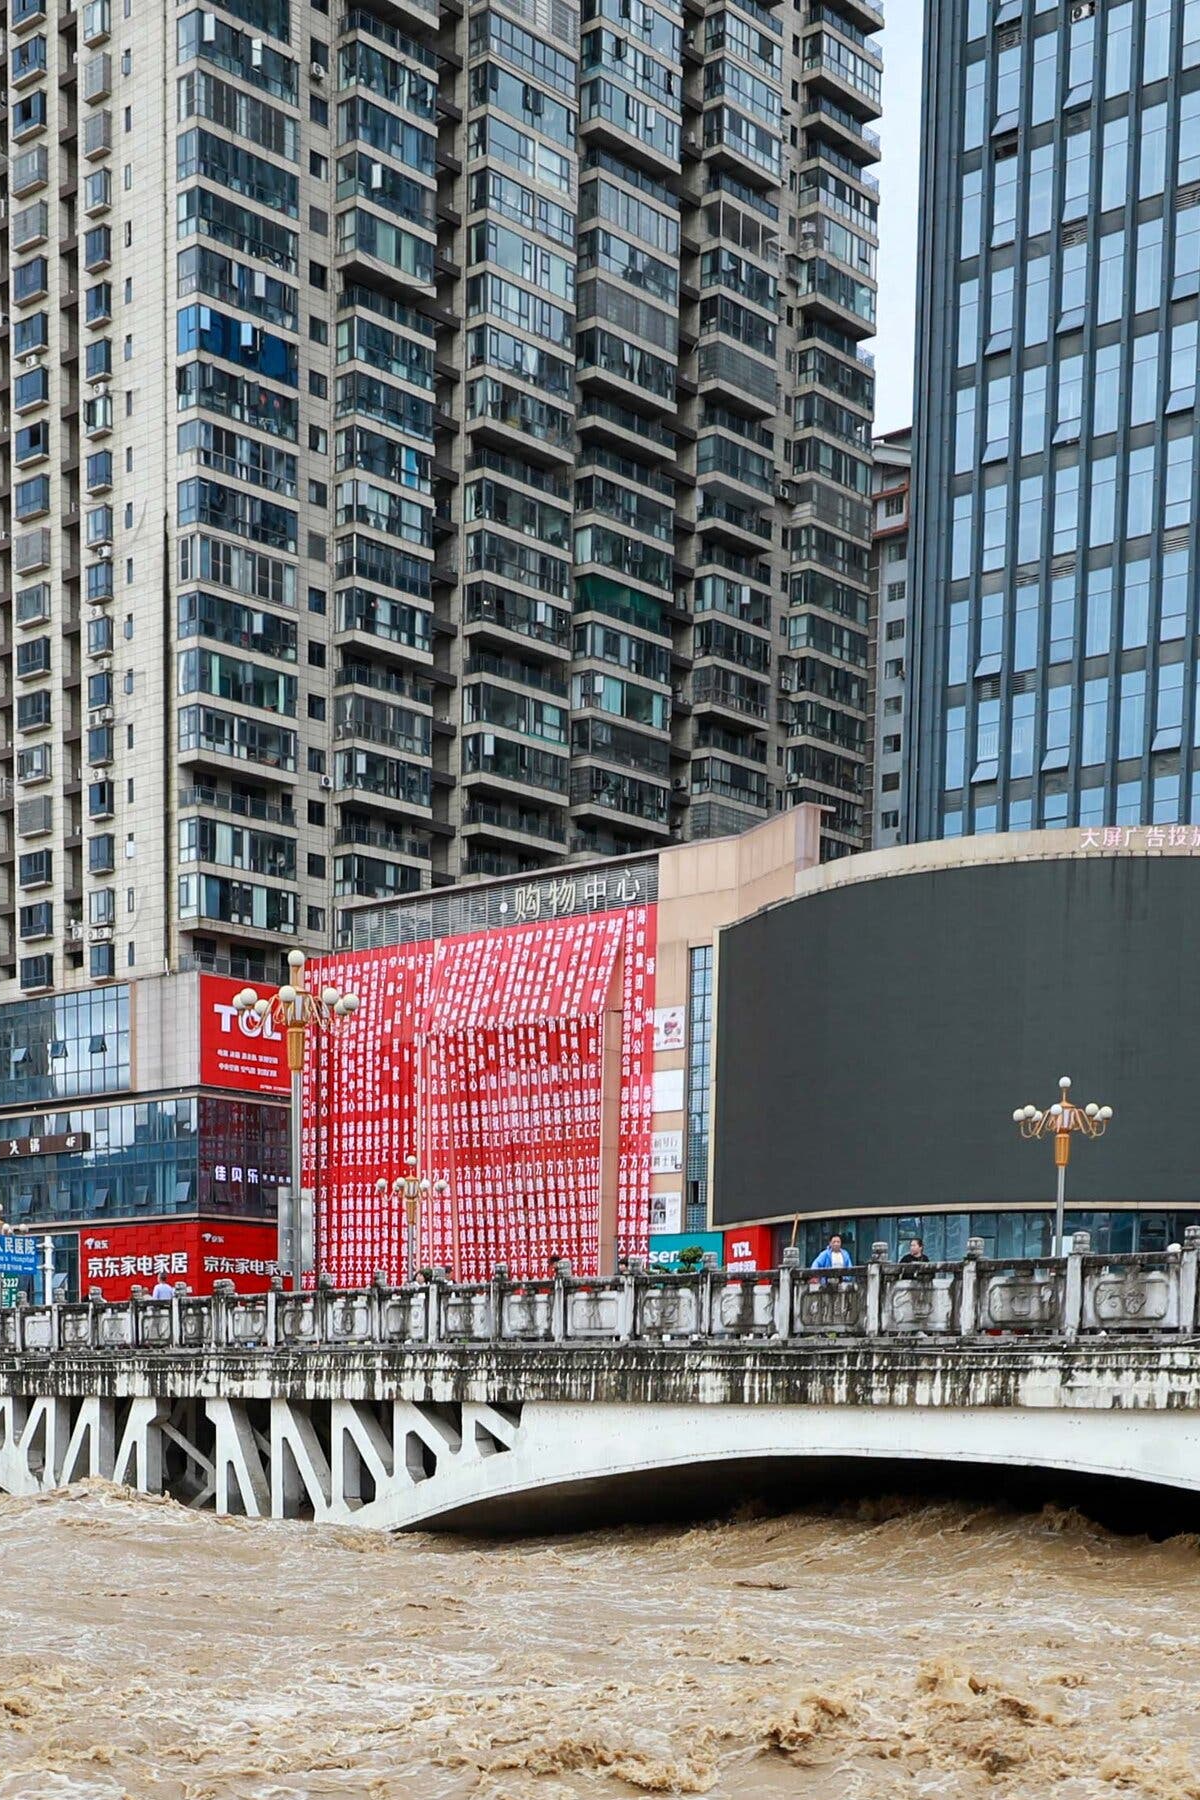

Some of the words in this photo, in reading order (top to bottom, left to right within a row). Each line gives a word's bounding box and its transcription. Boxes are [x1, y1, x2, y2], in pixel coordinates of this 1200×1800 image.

[514, 869, 640, 922] 购物中心
[633, 909, 646, 1076] 海信集团有限公司
[213, 1003, 282, 1041] TCL
[215, 1165, 258, 1184] 佳贝乐
[87, 1252, 188, 1278] 京东家电家居
[732, 1241, 752, 1258] TCL
